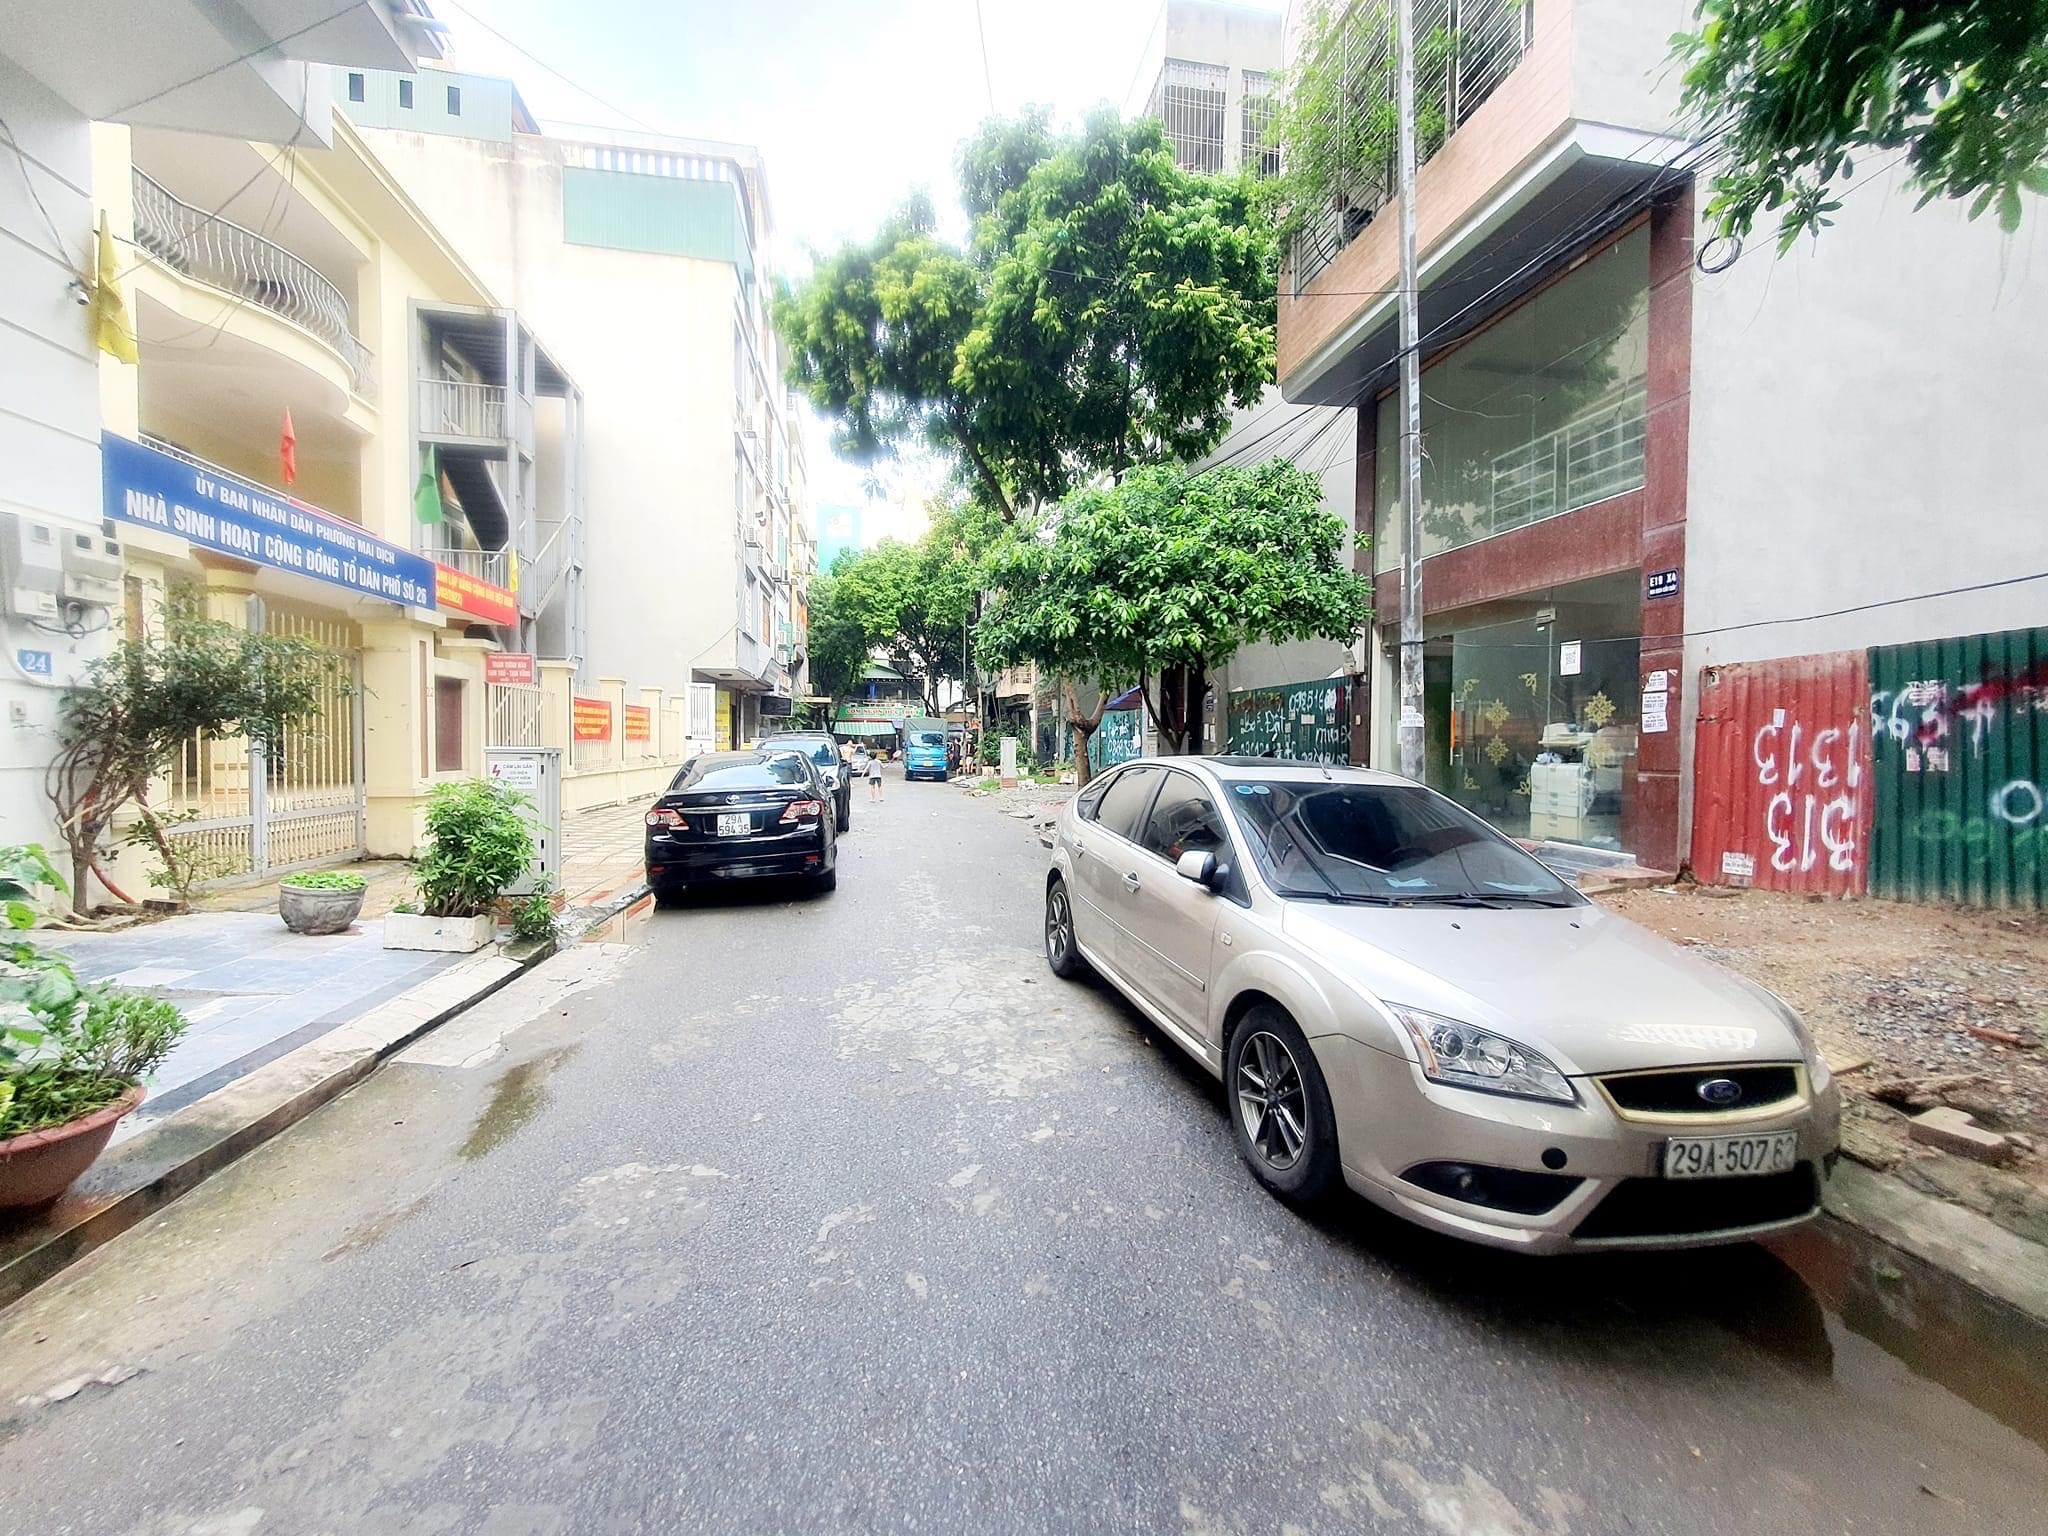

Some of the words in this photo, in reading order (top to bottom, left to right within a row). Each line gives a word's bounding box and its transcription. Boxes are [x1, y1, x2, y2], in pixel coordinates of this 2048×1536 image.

[126, 489, 168, 527] NHÀ
[173, 505, 215, 541] SINH
[220, 521, 261, 556] HOẠT
[265, 534, 303, 566] CỘNG
[306, 547, 339, 579] ĐỒNG
[342, 556, 357, 583] TỔ
[359, 566, 380, 591] DÂN
[382, 574, 401, 596] PHỐ
[402, 579, 415, 601] SỐ
[416, 587, 427, 604] 26
[195, 472, 215, 498] ỦY
[220, 487, 248, 511] BAN
[252, 499, 287, 525] NHÂN
[290, 513, 313, 536] DÂN
[316, 523, 356, 549] PHƯỜNG
[358, 538, 374, 558] MAI
[376, 547, 395, 566] DỊCH
[26, 653, 47, 671] 24
[724, 814, 743, 825] 29A
